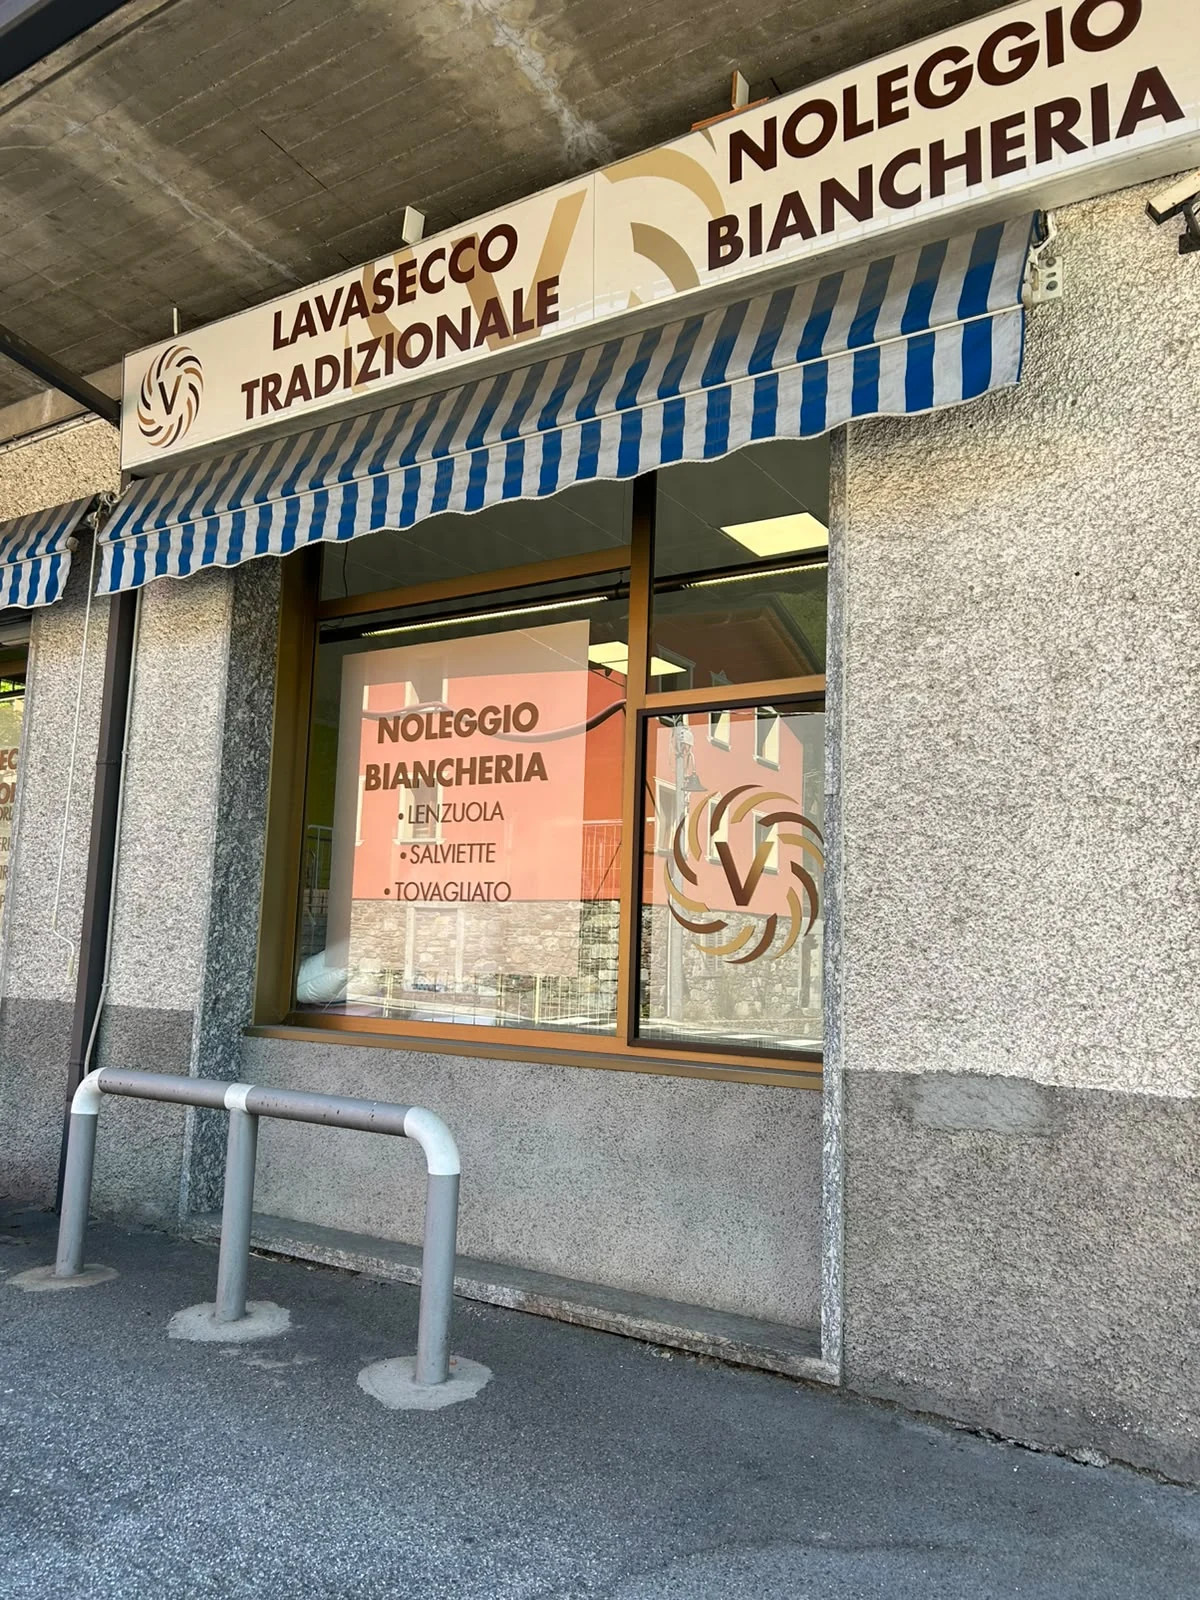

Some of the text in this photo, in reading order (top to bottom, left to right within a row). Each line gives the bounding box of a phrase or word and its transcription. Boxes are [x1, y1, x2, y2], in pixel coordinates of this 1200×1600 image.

[729, 0, 1143, 183] NOLEGGIO
[707, 66, 1185, 270] BIANCHERIA
[273, 223, 519, 350] LAVASECCO
[241, 275, 560, 419] TRADIZIONALE
[377, 701, 540, 745] NOLEGGIO
[365, 752, 548, 791] BIANCHERIA
[408, 800, 505, 825] LENZUOLA
[410, 843, 496, 864] SALVIETTE
[394, 881, 512, 902] TOVAGLIATO
